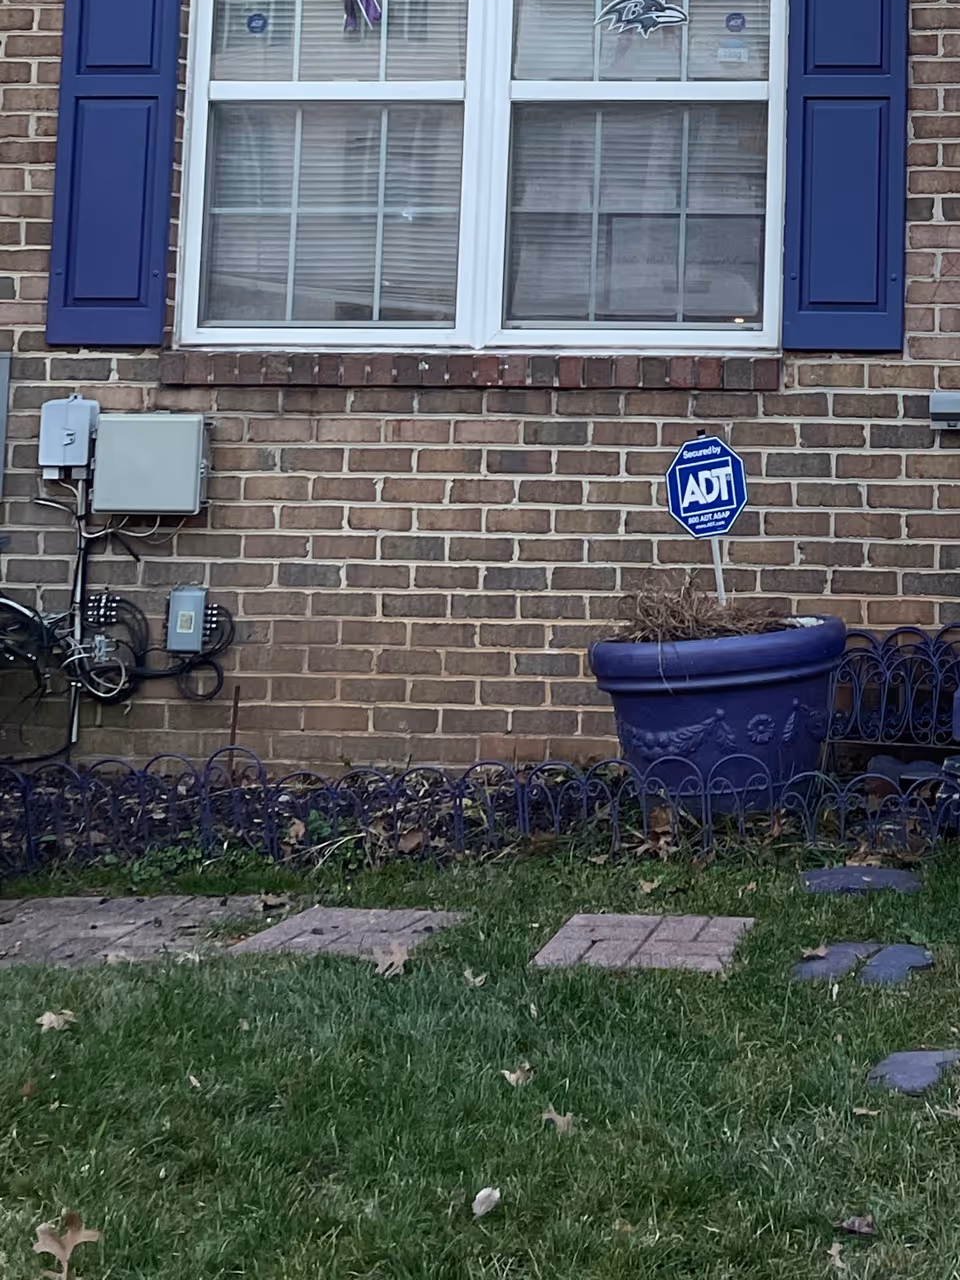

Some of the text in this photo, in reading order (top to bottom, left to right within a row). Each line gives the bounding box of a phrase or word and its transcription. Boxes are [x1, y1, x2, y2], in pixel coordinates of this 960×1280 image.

[683, 445, 721, 459] Secured by
[682, 466, 732, 507] ADT
